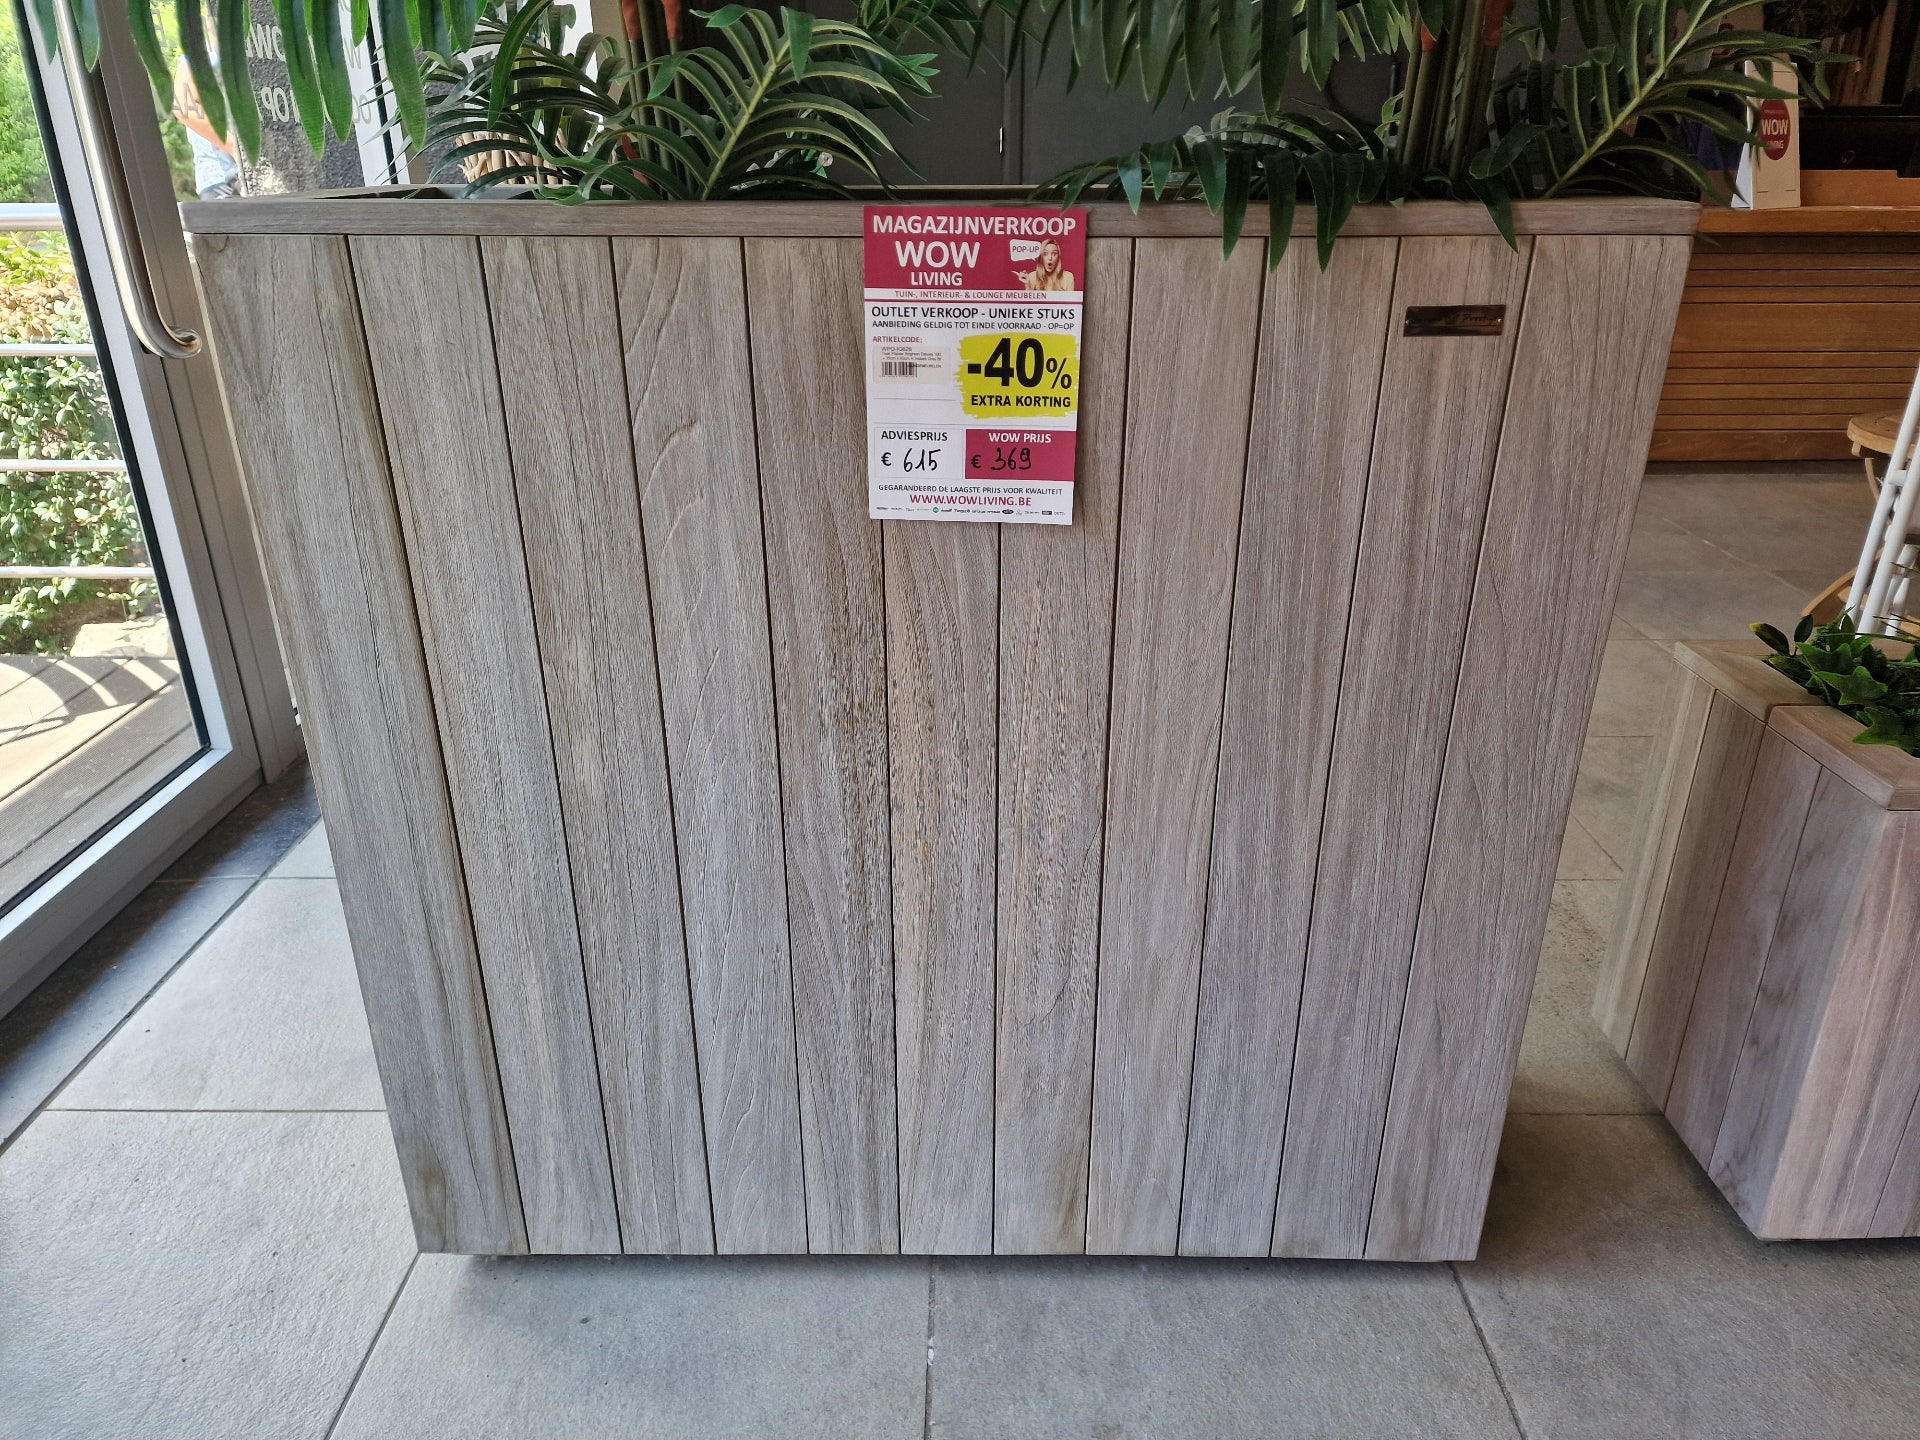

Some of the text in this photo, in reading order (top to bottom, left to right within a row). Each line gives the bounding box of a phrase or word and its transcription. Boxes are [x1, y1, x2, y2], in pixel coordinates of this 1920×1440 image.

[1761, 119, 1789, 136] WOW
[873, 215, 1076, 236] MAGAZIJNVERKOOP
[895, 240, 980, 269] WOW
[1012, 245, 1040, 254] POP-UP
[911, 271, 963, 287] LIVING
[964, 291, 971, 299] &
[972, 291, 1004, 299] LOUNGE
[1005, 292, 1047, 300] MEUBELEN
[871, 306, 918, 318] OUTLET
[921, 307, 979, 319] VERKOOP
[989, 308, 1034, 319] UNIEKE
[1037, 308, 1075, 319] STUKS
[872, 320, 922, 328] AANBIEDING
[923, 321, 953, 329] GELDIG
[954, 321, 970, 329] TOT
[997, 322, 1042, 330] VOORRAAD
[1048, 322, 1075, 330] OP=OP
[873, 336, 923, 344] ARTIKELCODE:
[971, 395, 1071, 408] EXTRA KORTING
[881, 430, 948, 442] ADVIESPRIJS
[988, 432, 1052, 444] WOW PRIJS
[881, 448, 941, 473] € 615
[971, 447, 1032, 471] € 369
[878, 484, 937, 492] GEGARANDEERD
[910, 494, 1032, 506] WWW.WOWLIVING.BE
